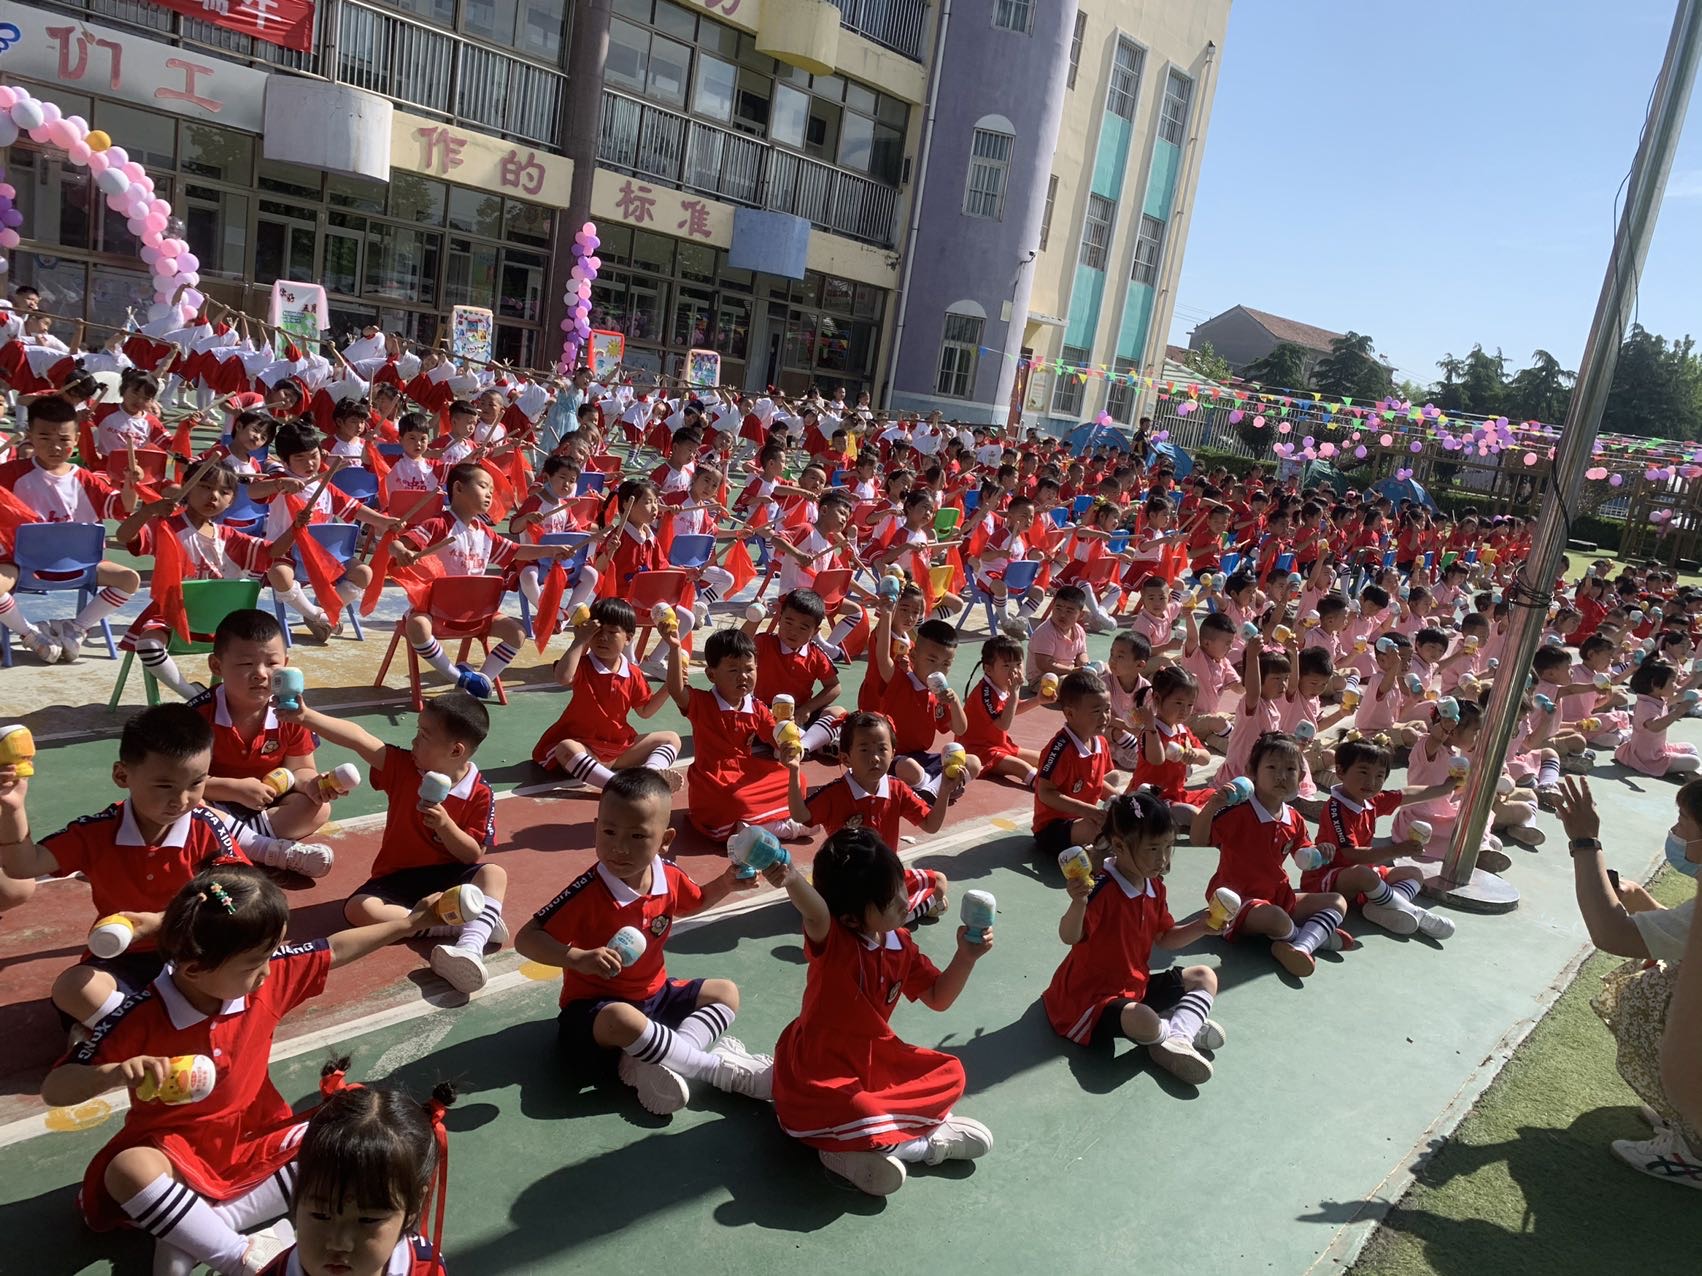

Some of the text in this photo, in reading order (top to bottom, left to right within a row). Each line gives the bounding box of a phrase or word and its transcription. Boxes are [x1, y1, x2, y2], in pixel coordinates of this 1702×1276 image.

[204, 811, 219, 825] PA
[1333, 819, 1346, 843] XIONG
[111, 1001, 135, 1017] PA
